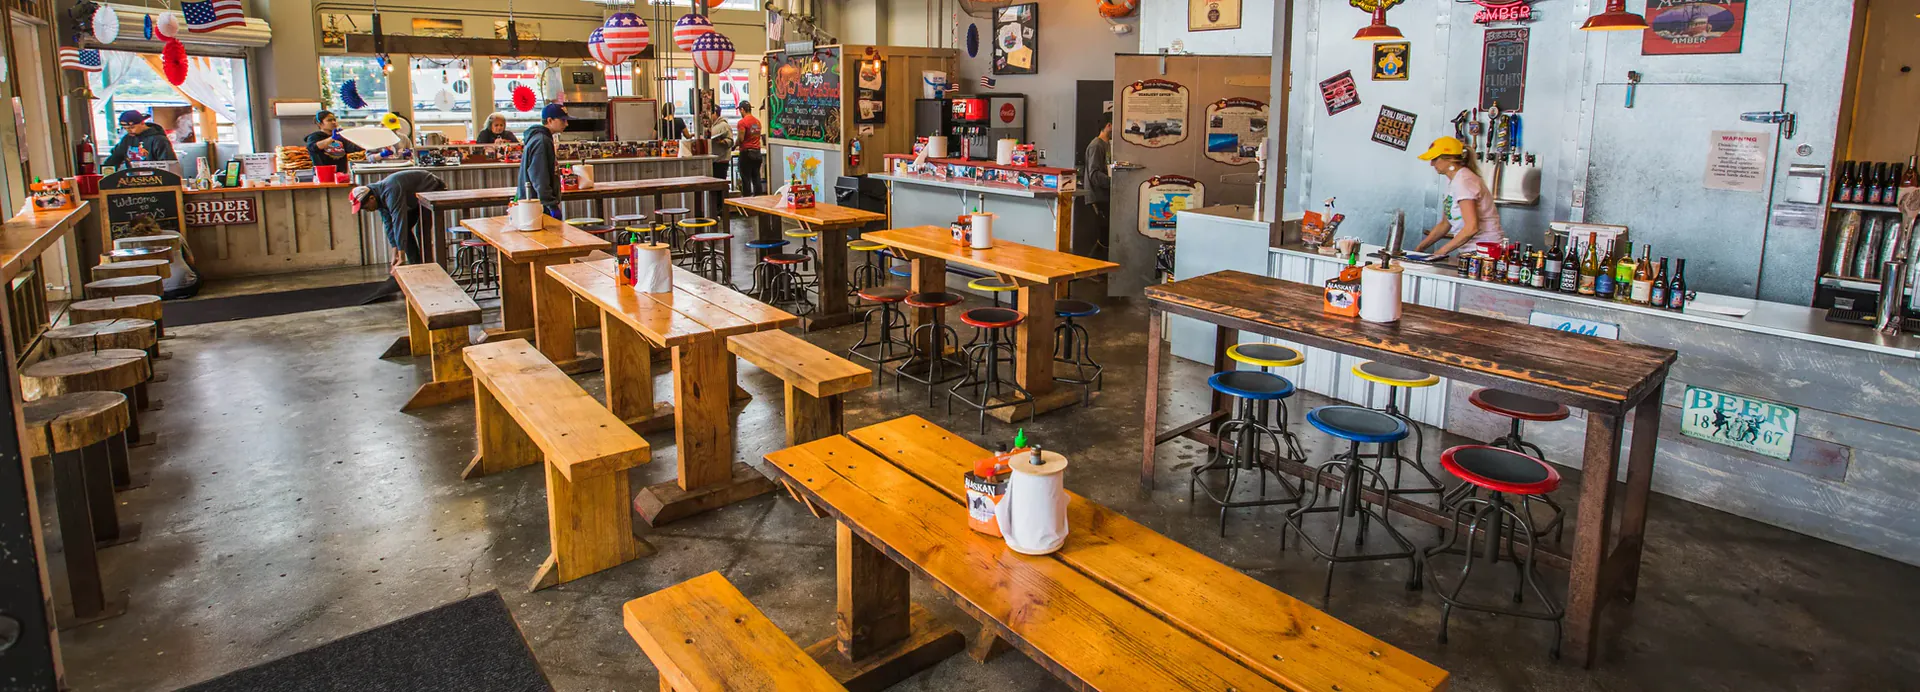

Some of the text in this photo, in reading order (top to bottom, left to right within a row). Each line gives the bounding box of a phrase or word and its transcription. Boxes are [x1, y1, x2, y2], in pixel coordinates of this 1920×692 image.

[1473, 6, 1530, 24] AMBER
[1486, 31, 1518, 42] BEER
[1671, 36, 1707, 45] AMBER
[1488, 45, 1523, 57] BEER
[1485, 72, 1521, 87] FLIGHTS
[1376, 124, 1409, 140] STOUT
[1379, 116, 1412, 133] CHULI
[117, 175, 163, 187] ALASKAN
[112, 196, 158, 208] Welcome
[184, 200, 250, 214] ORDER
[185, 210, 250, 225] SHACK
[1690, 389, 1790, 433] BEER
[1693, 413, 1784, 446] 18 67
